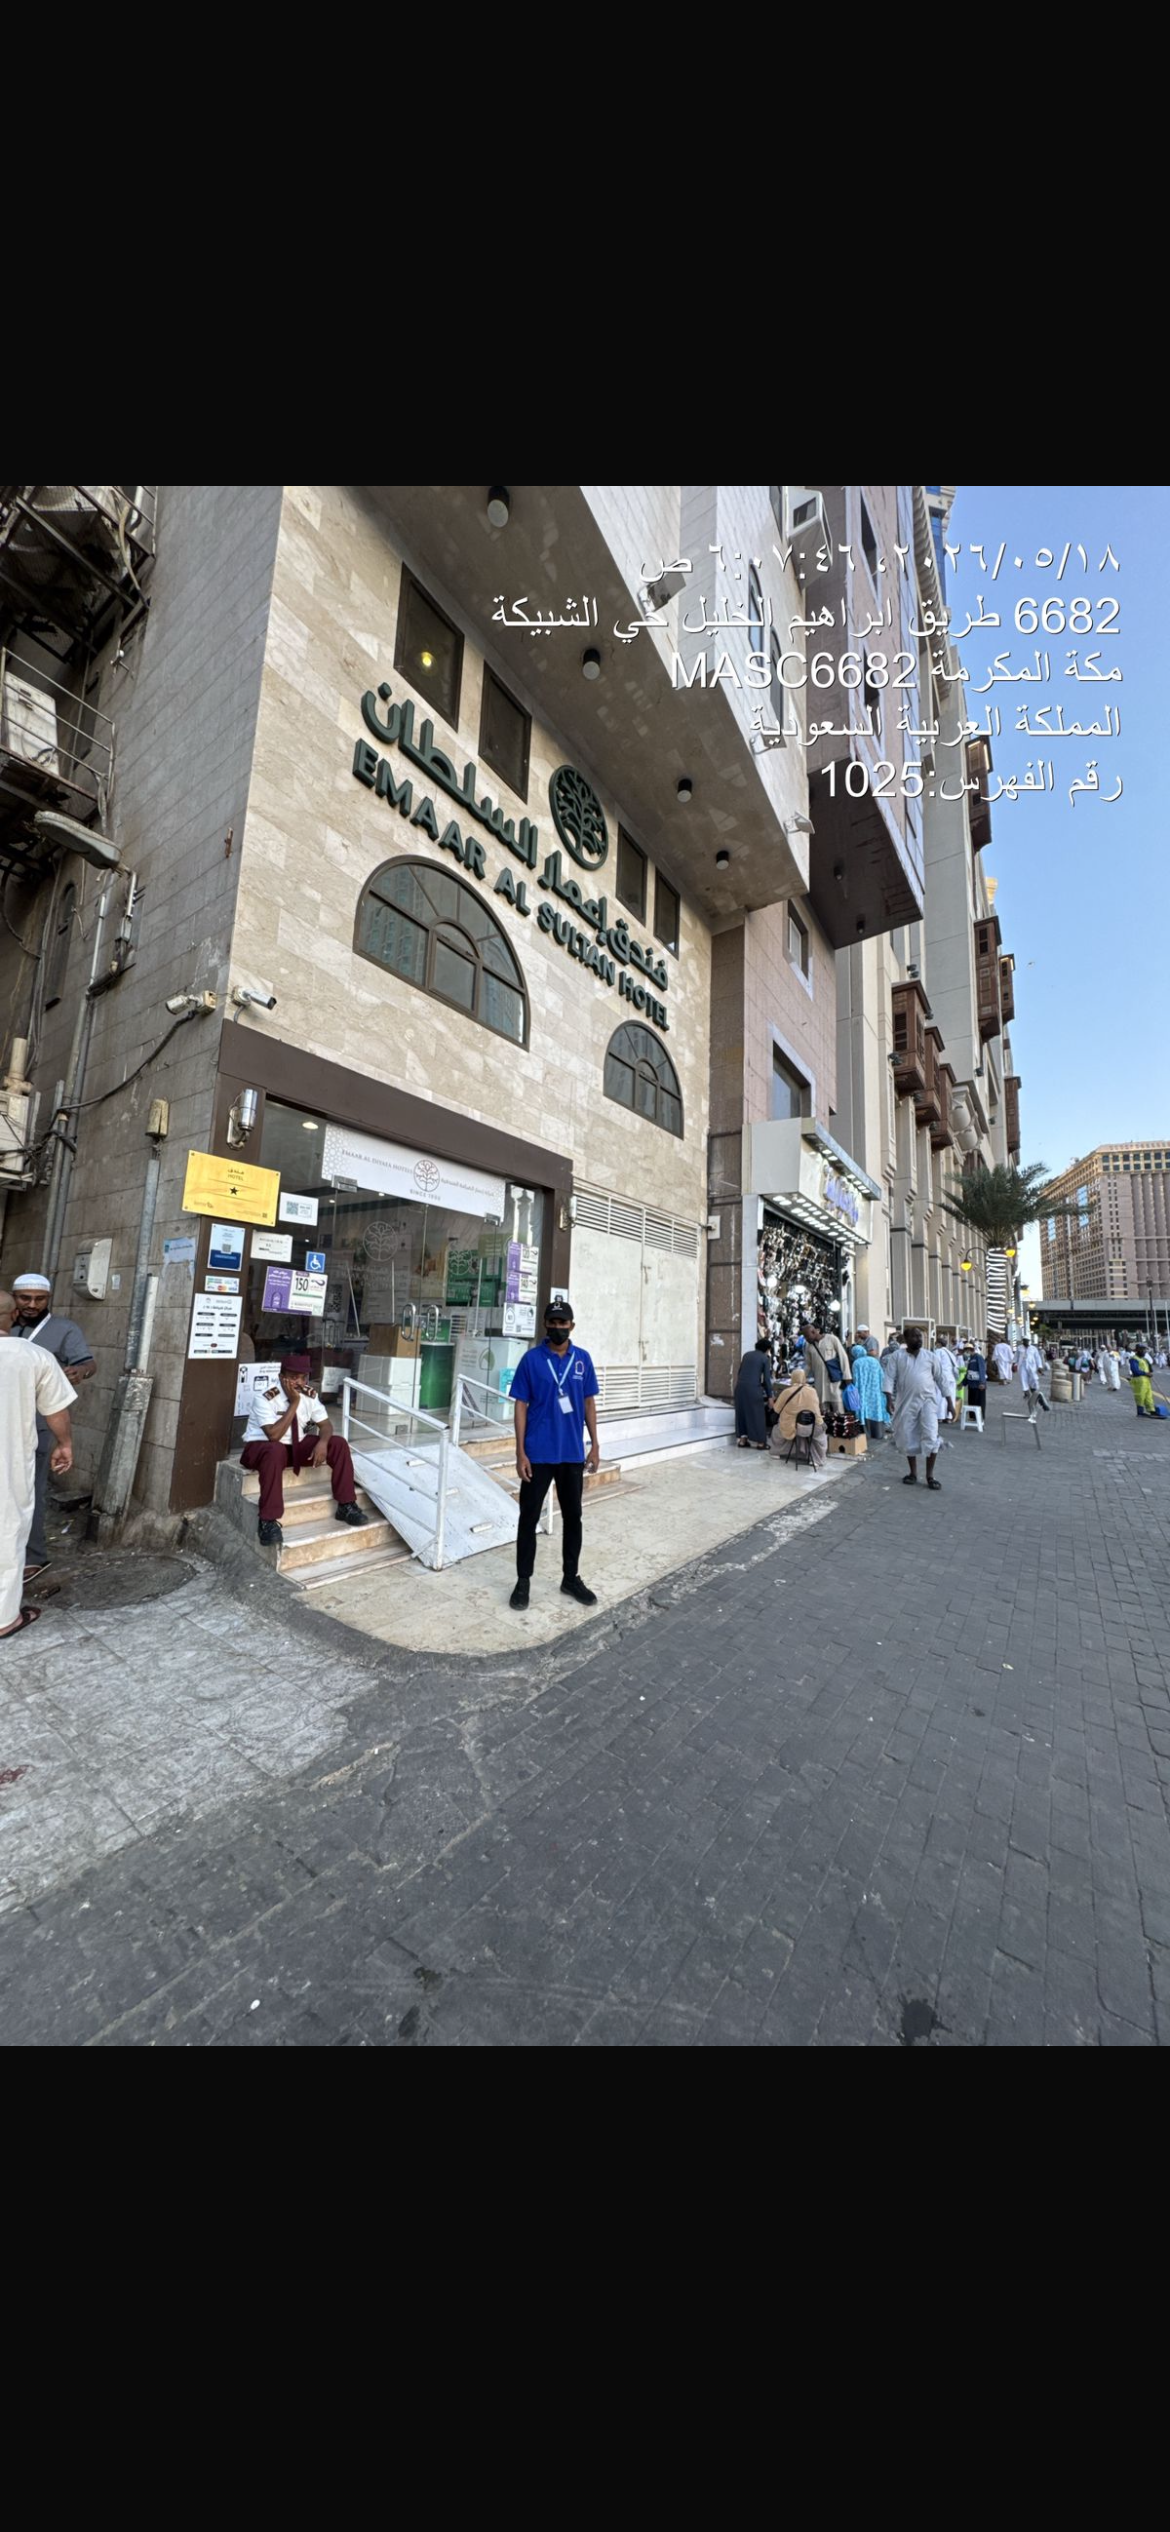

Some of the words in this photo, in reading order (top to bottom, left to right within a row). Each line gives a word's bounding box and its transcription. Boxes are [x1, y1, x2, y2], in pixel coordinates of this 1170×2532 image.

[361, 682, 538, 870] السلطان
[352, 737, 486, 881] EMAAR
[493, 867, 531, 917] AL
[537, 901, 616, 987] SULTAN
[618, 971, 669, 1032] HOTEL
[537, 849, 608, 947] إعمار
[606, 918, 668, 992] فندق
[296, 1277, 309, 1291] 150
